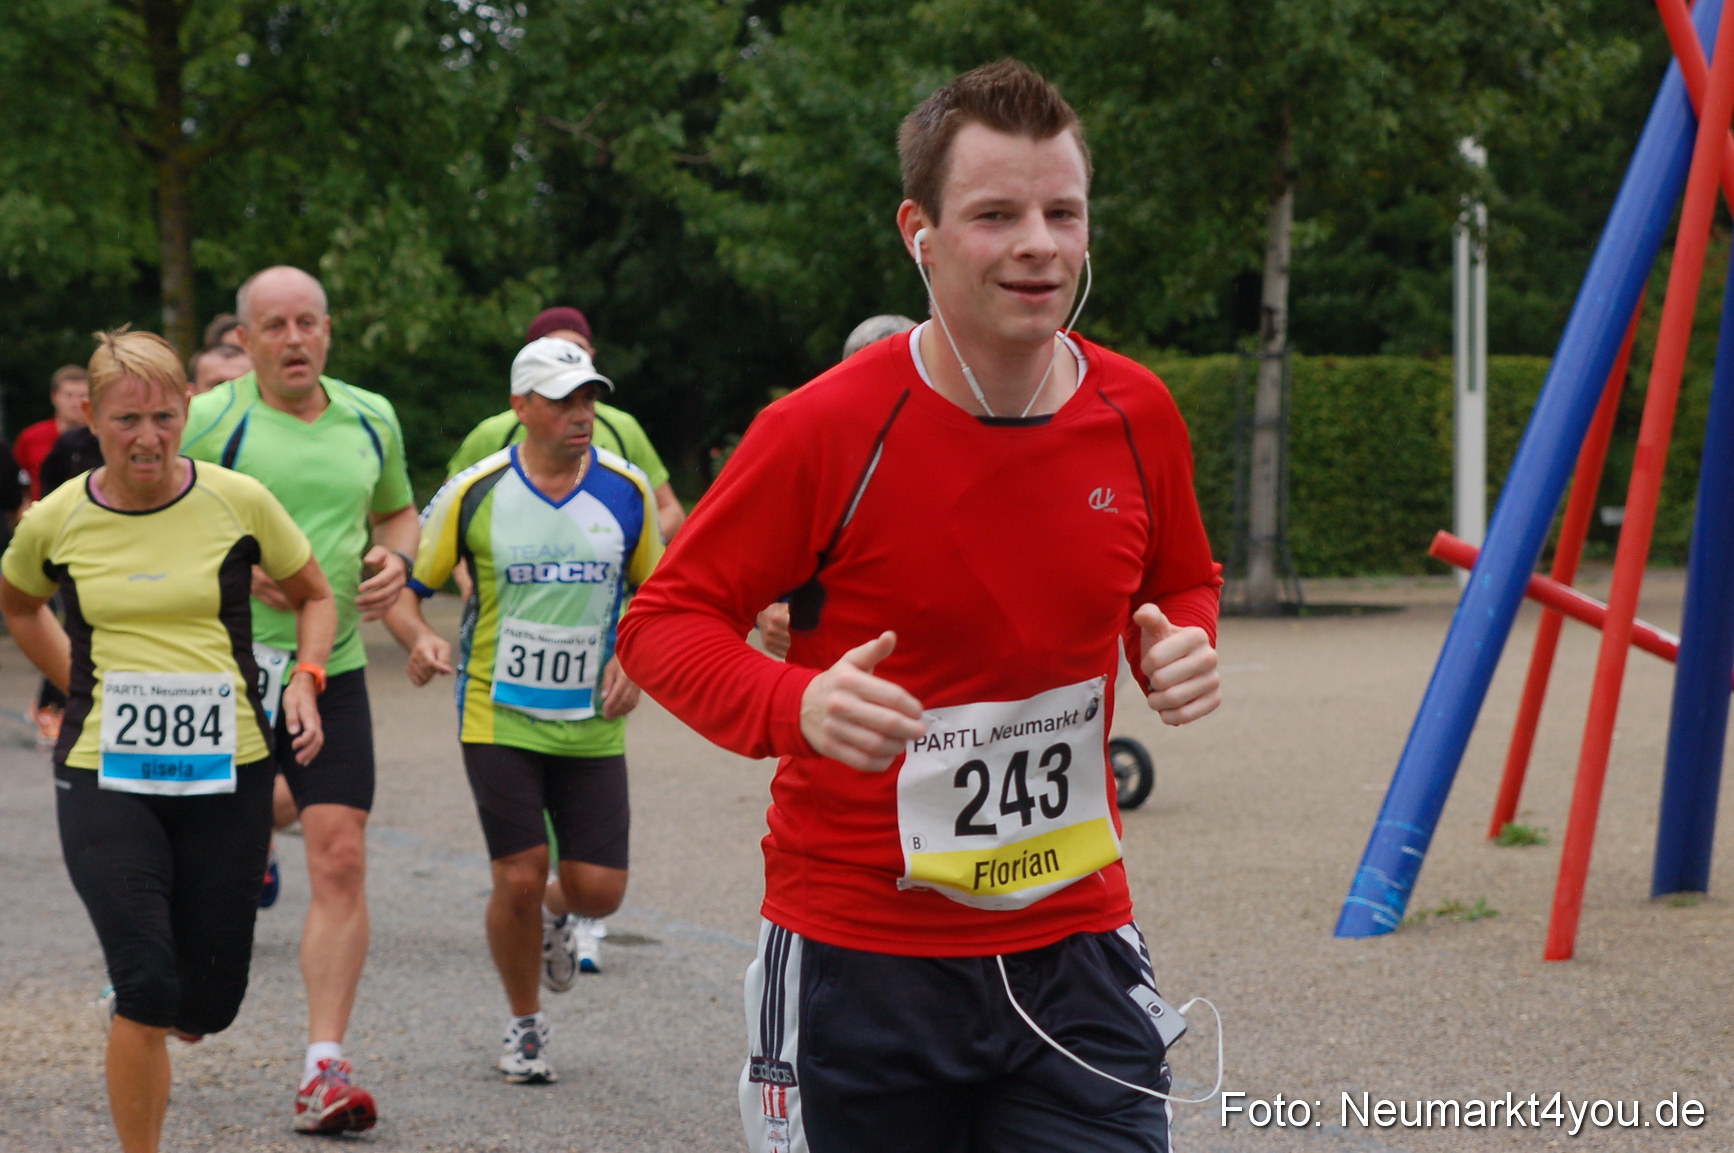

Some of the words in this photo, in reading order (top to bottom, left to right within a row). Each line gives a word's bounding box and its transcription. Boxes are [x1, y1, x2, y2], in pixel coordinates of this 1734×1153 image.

[509, 544, 576, 560] TEAM
[505, 561, 610, 585] BOCK
[507, 644, 587, 683] 3101
[105, 684, 147, 697] PARTL
[150, 685, 214, 697] Neumarkt
[115, 703, 223, 747] 2984
[913, 728, 984, 753] PARTL
[989, 709, 1079, 744] Neumarkt
[953, 742, 1072, 837] 243
[912, 836, 922, 850] B
[972, 848, 1060, 890] Florian
